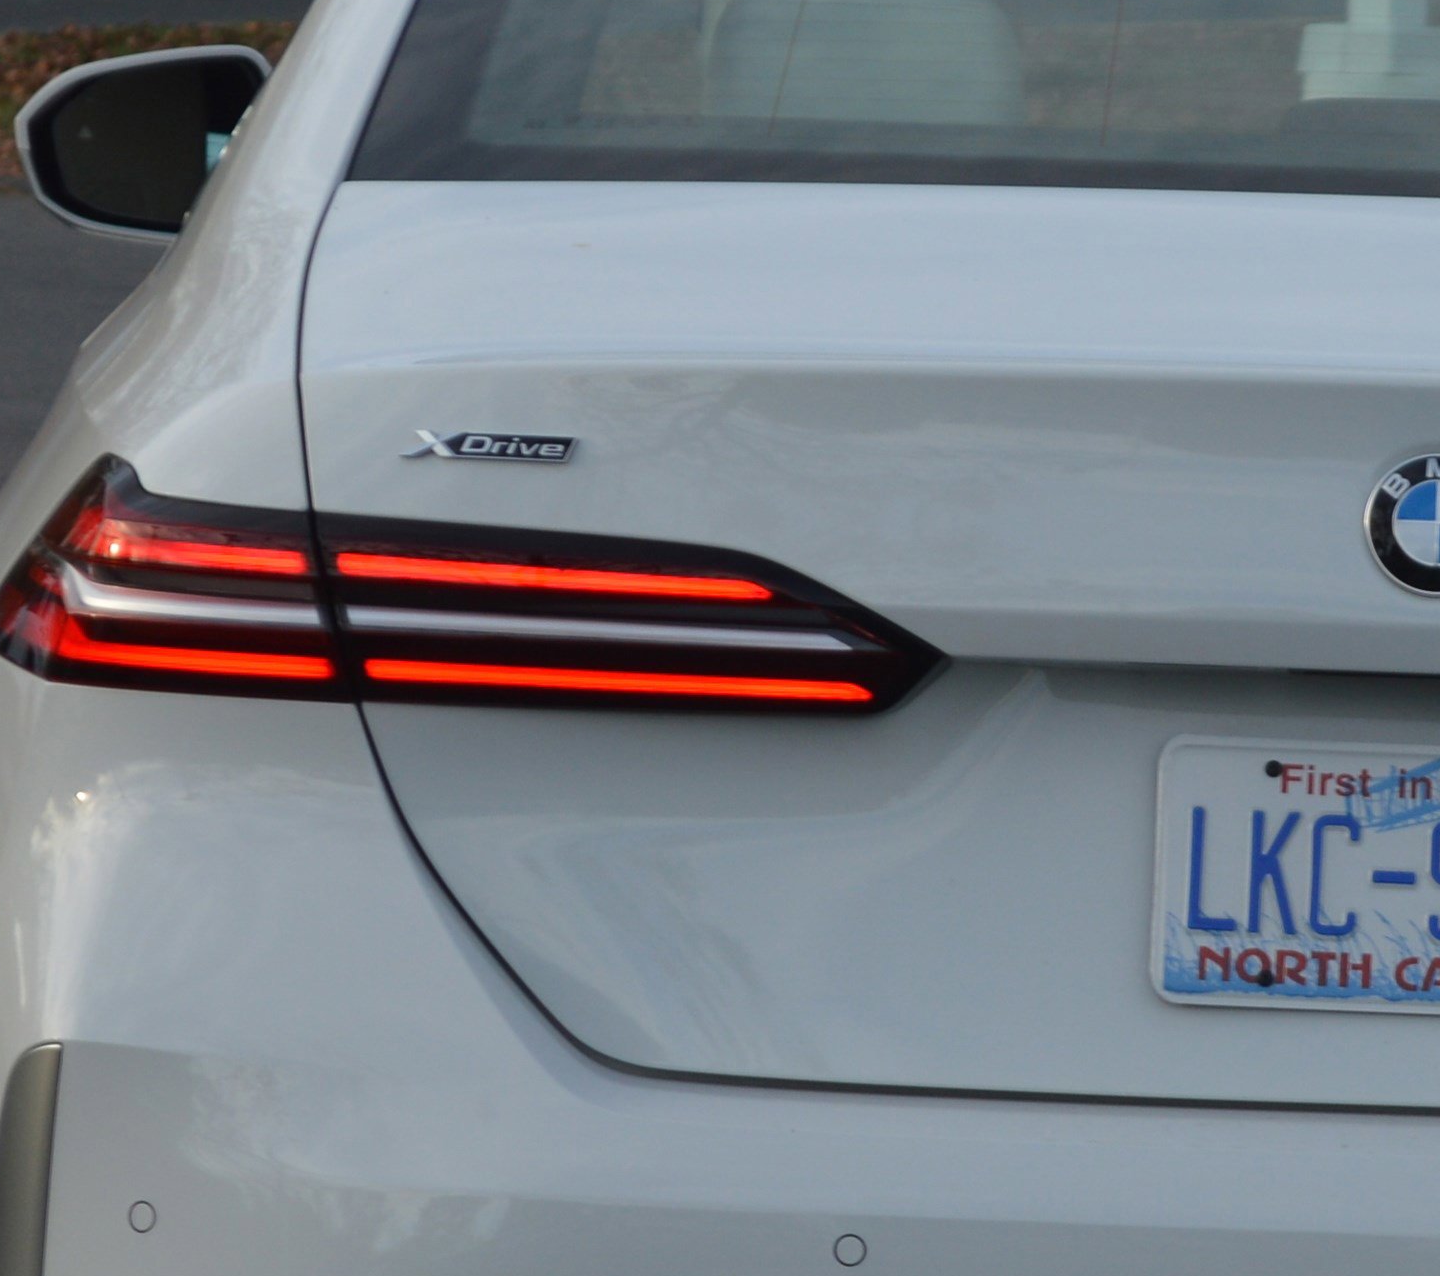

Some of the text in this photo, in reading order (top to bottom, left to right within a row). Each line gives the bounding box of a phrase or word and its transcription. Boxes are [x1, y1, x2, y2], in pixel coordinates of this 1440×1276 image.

[1278, 762, 1371, 798] First
[1398, 768, 1433, 800] in
[1197, 945, 1372, 990] NORTH
